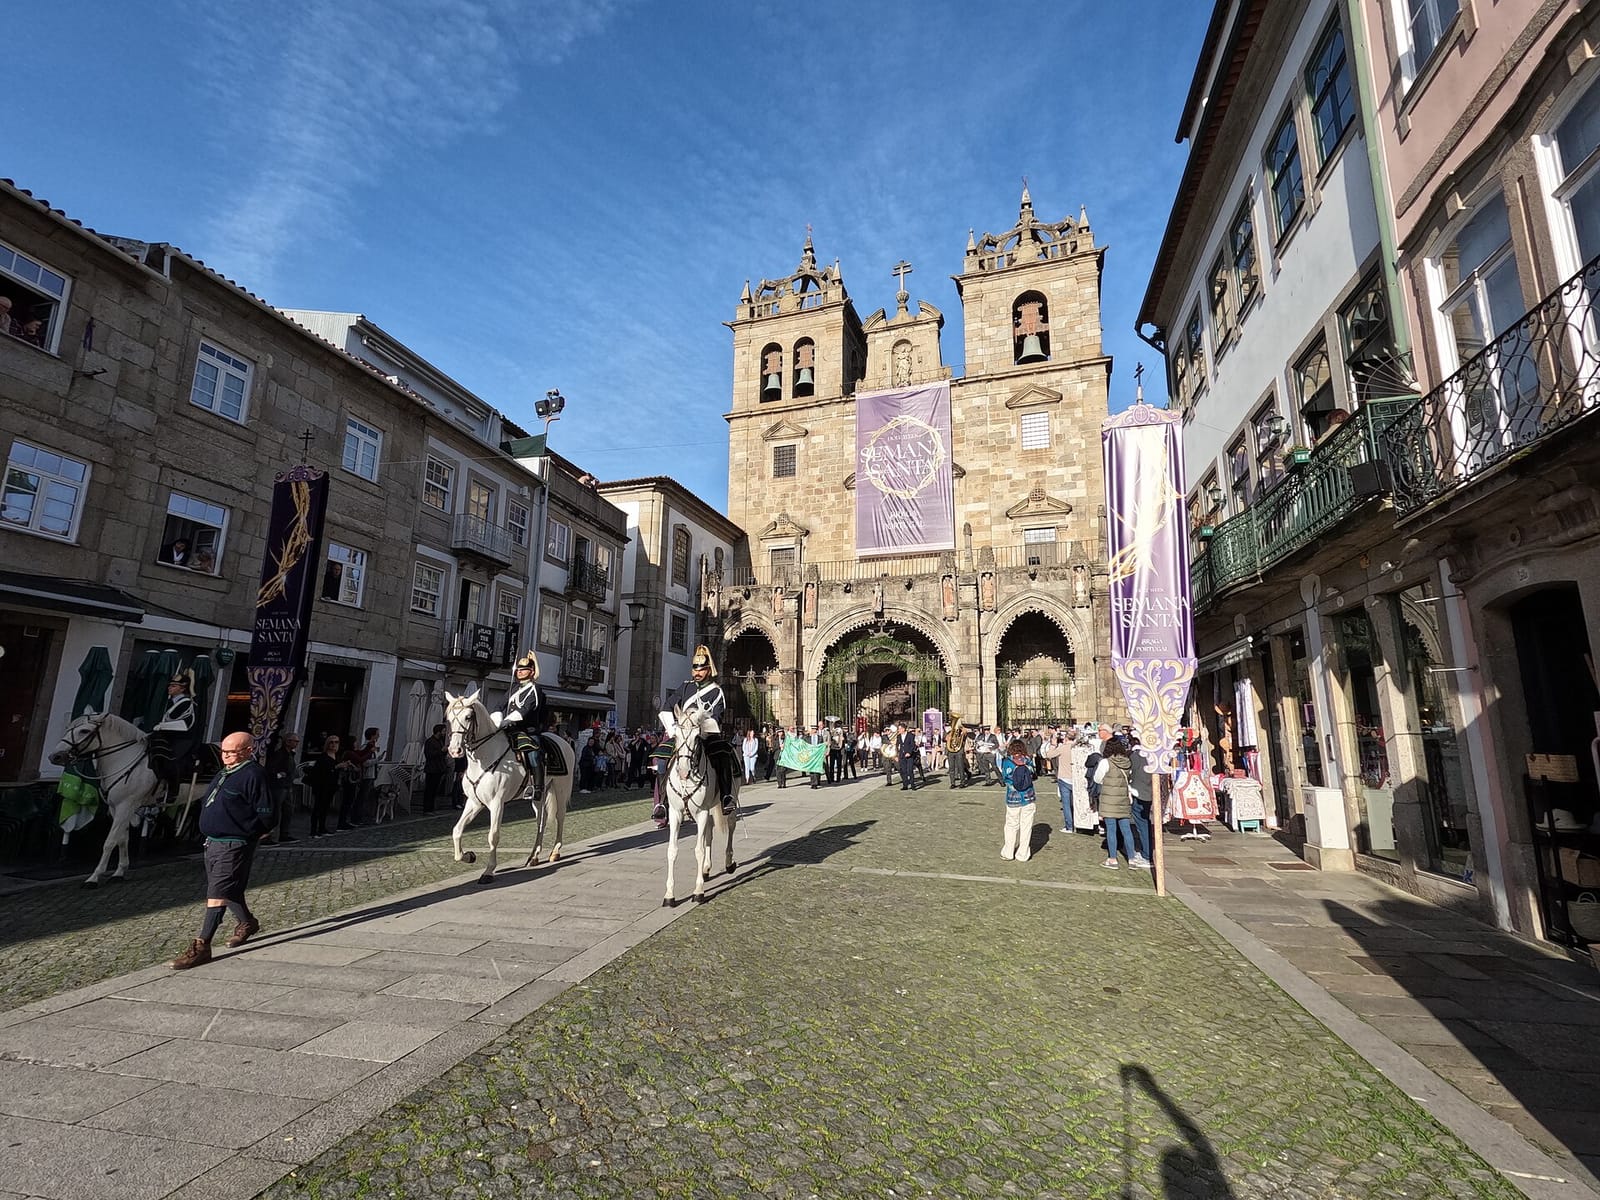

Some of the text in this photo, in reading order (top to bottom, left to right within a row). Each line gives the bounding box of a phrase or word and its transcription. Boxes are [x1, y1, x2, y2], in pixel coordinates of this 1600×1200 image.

[860, 440, 946, 463] SEMANA
[870, 459, 935, 480] SANTA
[1112, 596, 1191, 612] SEMANA
[256, 618, 302, 630] SEMANA
[1121, 613, 1182, 628] SANTA
[258, 631, 294, 643] SANTA
